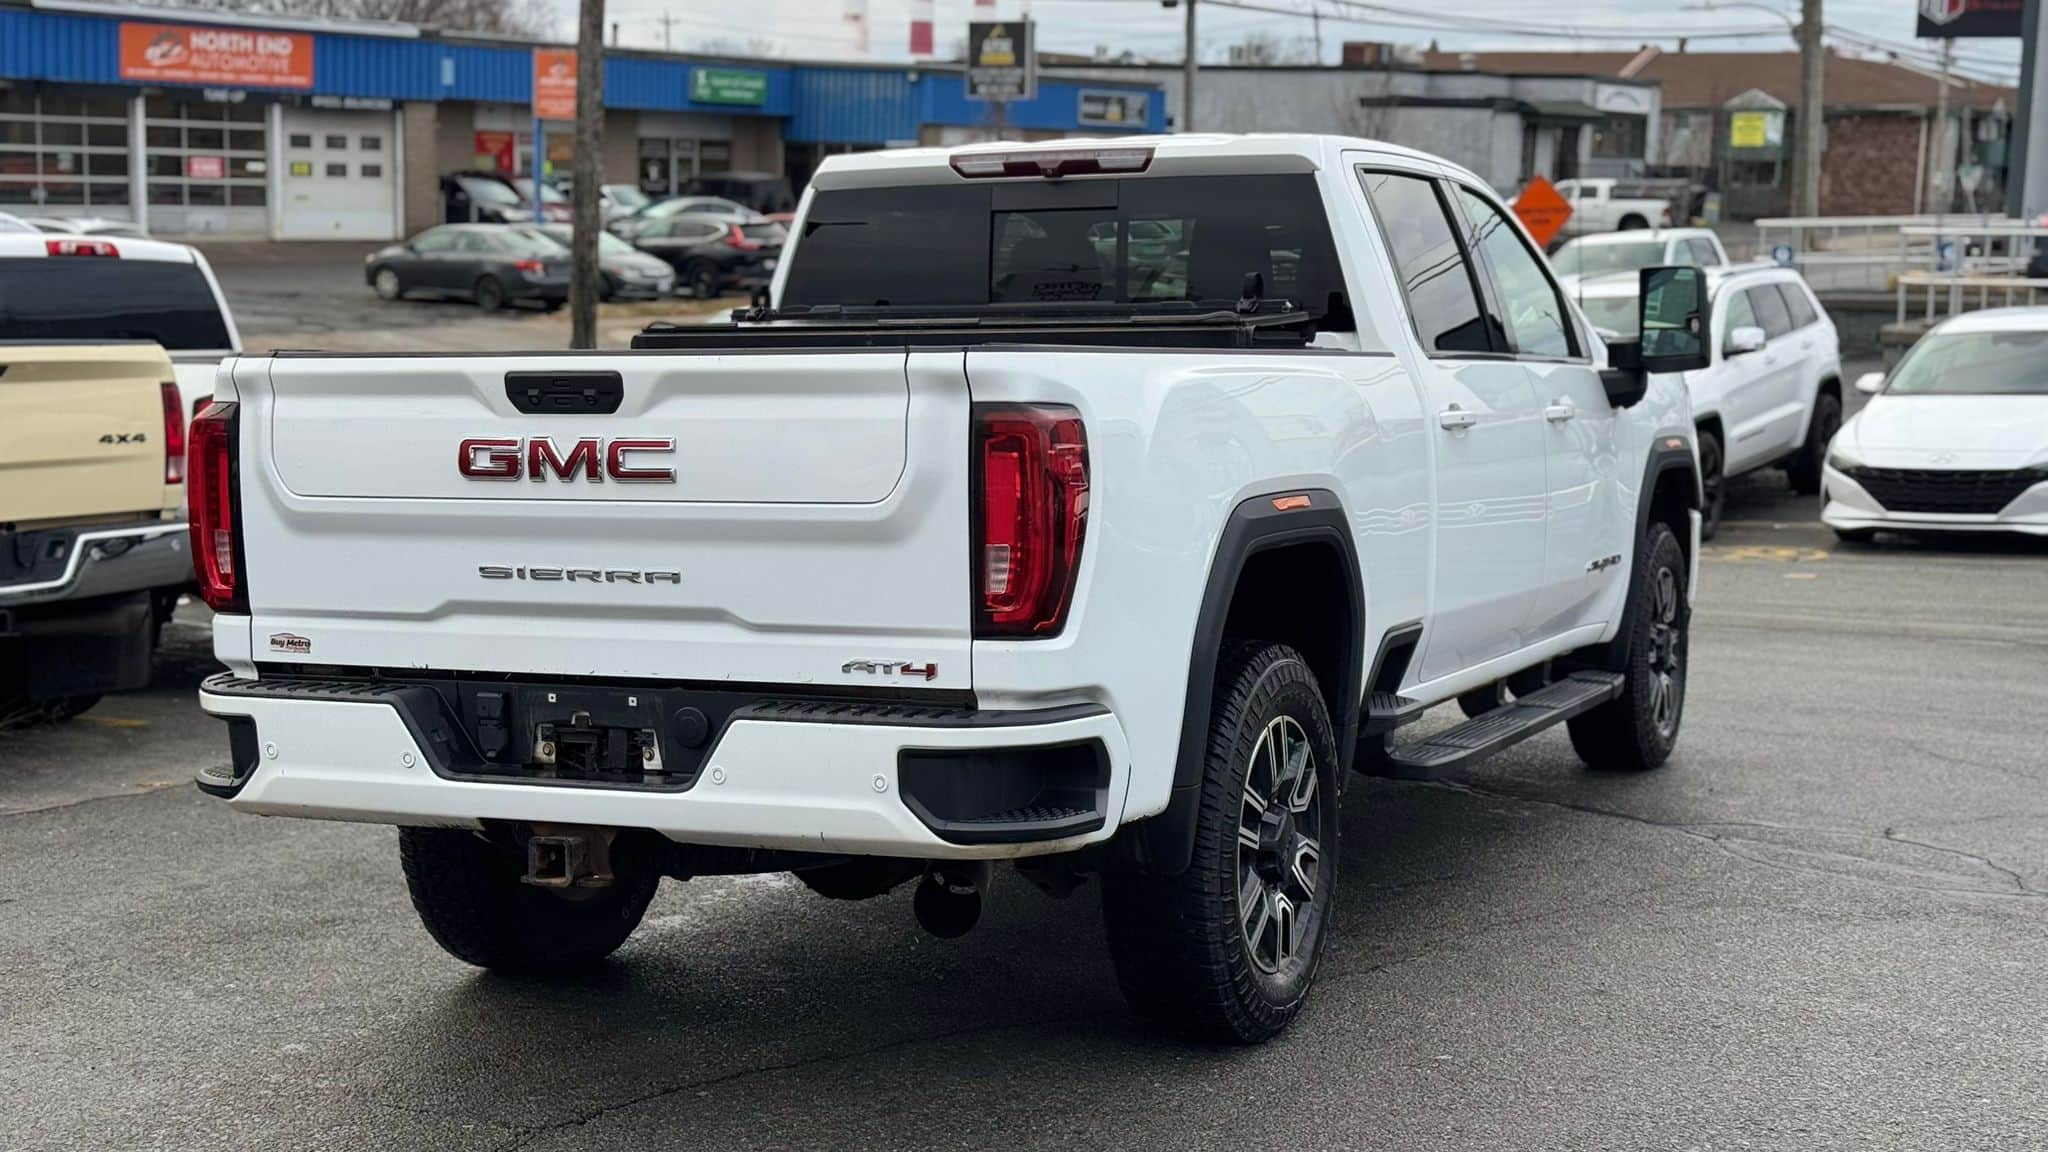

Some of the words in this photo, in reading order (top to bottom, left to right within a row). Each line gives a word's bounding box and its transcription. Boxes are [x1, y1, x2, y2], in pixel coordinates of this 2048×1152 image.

[190, 32, 253, 53] NORTH
[256, 34, 293, 57] END
[189, 52, 290, 73] AUTOMOTIVE
[458, 436, 677, 484] GMC
[478, 565, 682, 585] SIERRA
[270, 638, 285, 648] Buy
[286, 639, 311, 648] Metro
[841, 659, 938, 681] AT4
